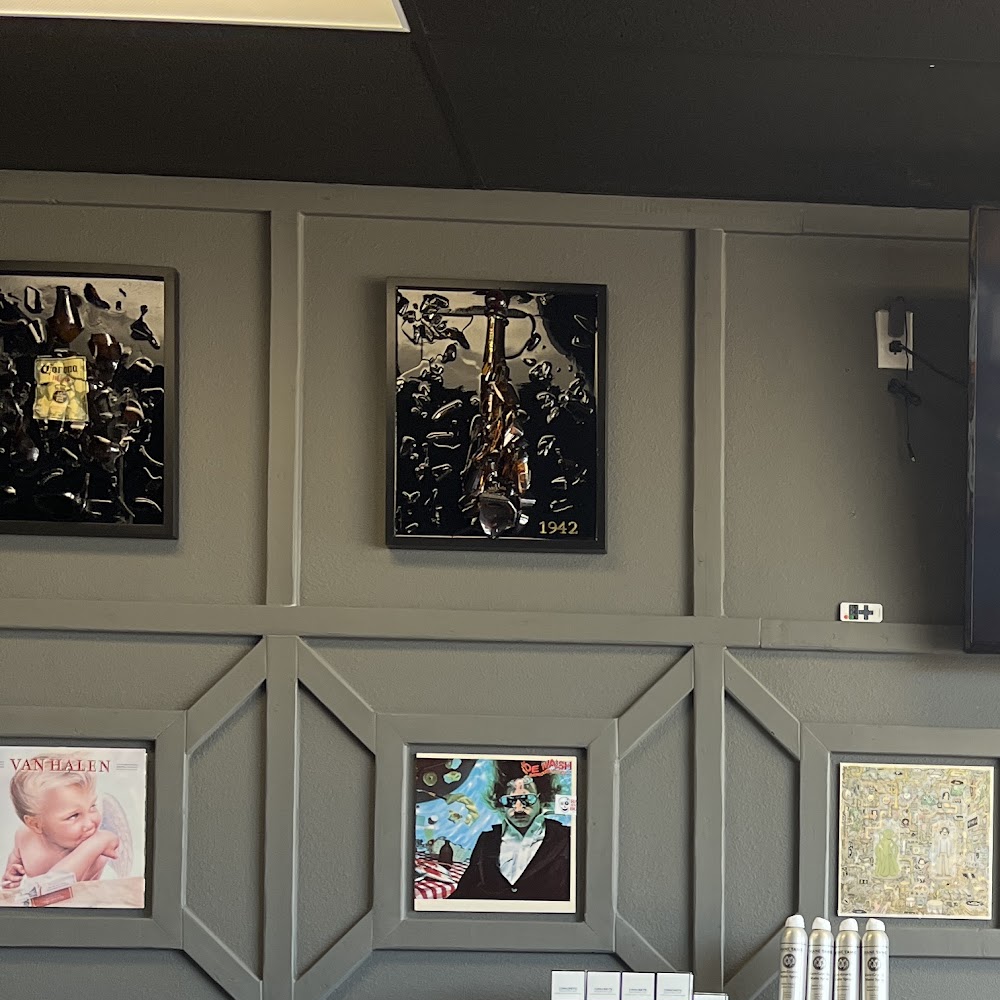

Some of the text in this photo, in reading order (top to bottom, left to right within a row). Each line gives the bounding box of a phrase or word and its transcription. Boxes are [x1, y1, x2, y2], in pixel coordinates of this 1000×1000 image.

[538, 520, 579, 535] 1942
[10, 758, 111, 772] VAN HALEN
